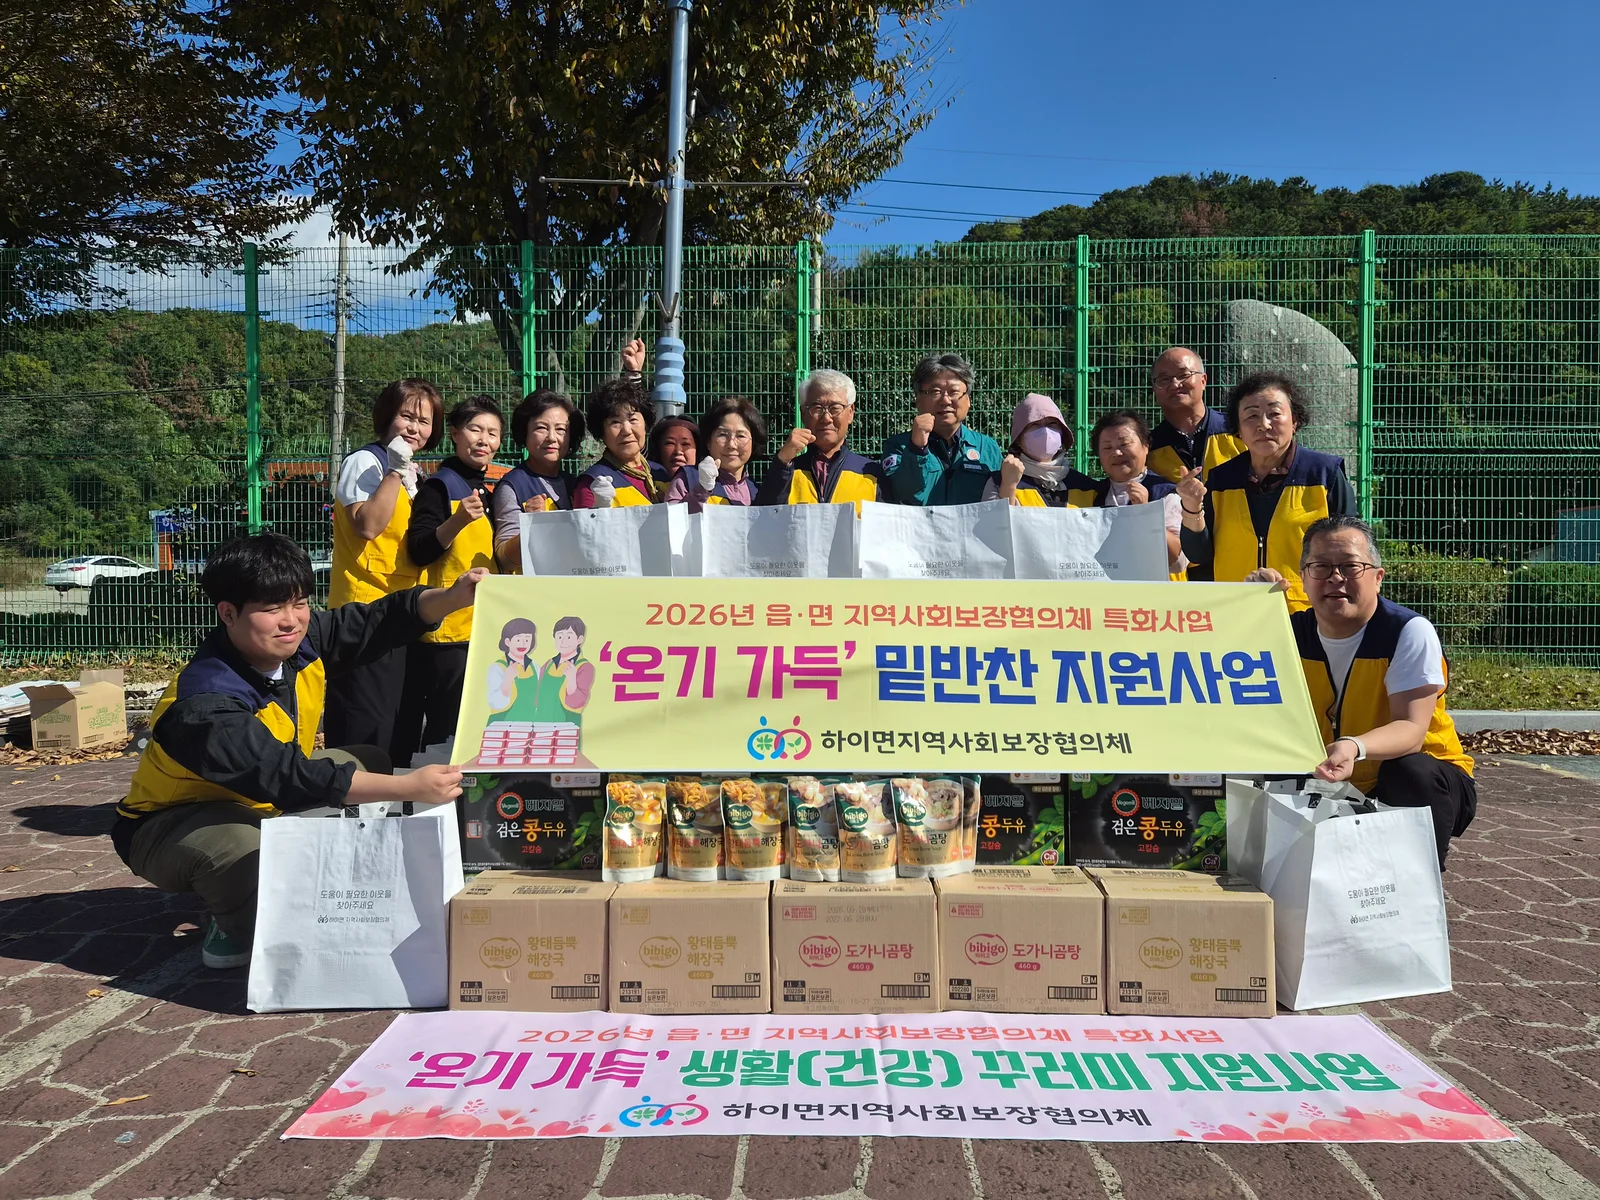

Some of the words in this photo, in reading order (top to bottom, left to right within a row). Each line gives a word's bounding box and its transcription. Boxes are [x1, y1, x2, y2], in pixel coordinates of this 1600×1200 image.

[646, 604, 755, 627] 2026년
[766, 604, 833, 627] 읍·면
[845, 605, 1093, 631] 지역사회보장협의체
[1103, 608, 1214, 633] 특화사업
[876, 646, 1039, 705] 밑반찬
[1053, 651, 1283, 706] 지원사업
[822, 731, 1132, 756] 하이면지역사회보장협의체
[524, 799, 565, 812] 베지밀
[984, 794, 1024, 807] 베지밀
[1141, 797, 1184, 810] 베지밀
[730, 808, 752, 819] bibigo
[796, 808, 819, 820] bibigo
[845, 811, 867, 822] bibigo
[521, 845, 542, 854] 고칼슘
[980, 841, 1001, 850] 고칼슘
[1138, 844, 1160, 853] 고칼슘
[320, 890, 343, 899] 도움이
[346, 890, 368, 899] 필요한
[369, 890, 392, 899] 이웃을
[1348, 889, 1364, 899] 도움이
[1364, 886, 1379, 897] 필요한
[1380, 884, 1396, 894] 이웃을
[337, 901, 374, 910] 찾아주세요
[1360, 896, 1386, 909] 찾아주세요
[527, 936, 577, 950] 황태듬뿍
[687, 935, 737, 950] 황태듬뿍
[969, 942, 1005, 957] bibigo
[1188, 938, 1242, 953] 황태듬뿍
[484, 946, 519, 959] bibigo
[644, 945, 679, 959] bibigo
[803, 944, 838, 958] bibigo
[846, 944, 914, 959] 도가니곰탕
[1012, 943, 1082, 960] 도가니곰탕
[1144, 945, 1180, 959] bibigo
[527, 952, 565, 967] 해장국
[687, 952, 725, 966] 해장국
[1188, 955, 1229, 970] 해장국
[518, 1026, 654, 1043] 2026년
[667, 1027, 752, 1043] 읍·면
[765, 1026, 1072, 1043] 지역사회보장협의체
[1084, 1028, 1224, 1043] 특화사업
[680, 1050, 963, 1089] 생활(건강)
[973, 1051, 1153, 1091] 꾸러미
[1151, 1052, 1404, 1092] 지원사업
[723, 1103, 1152, 1127] 하이면지역사회보장협의체
